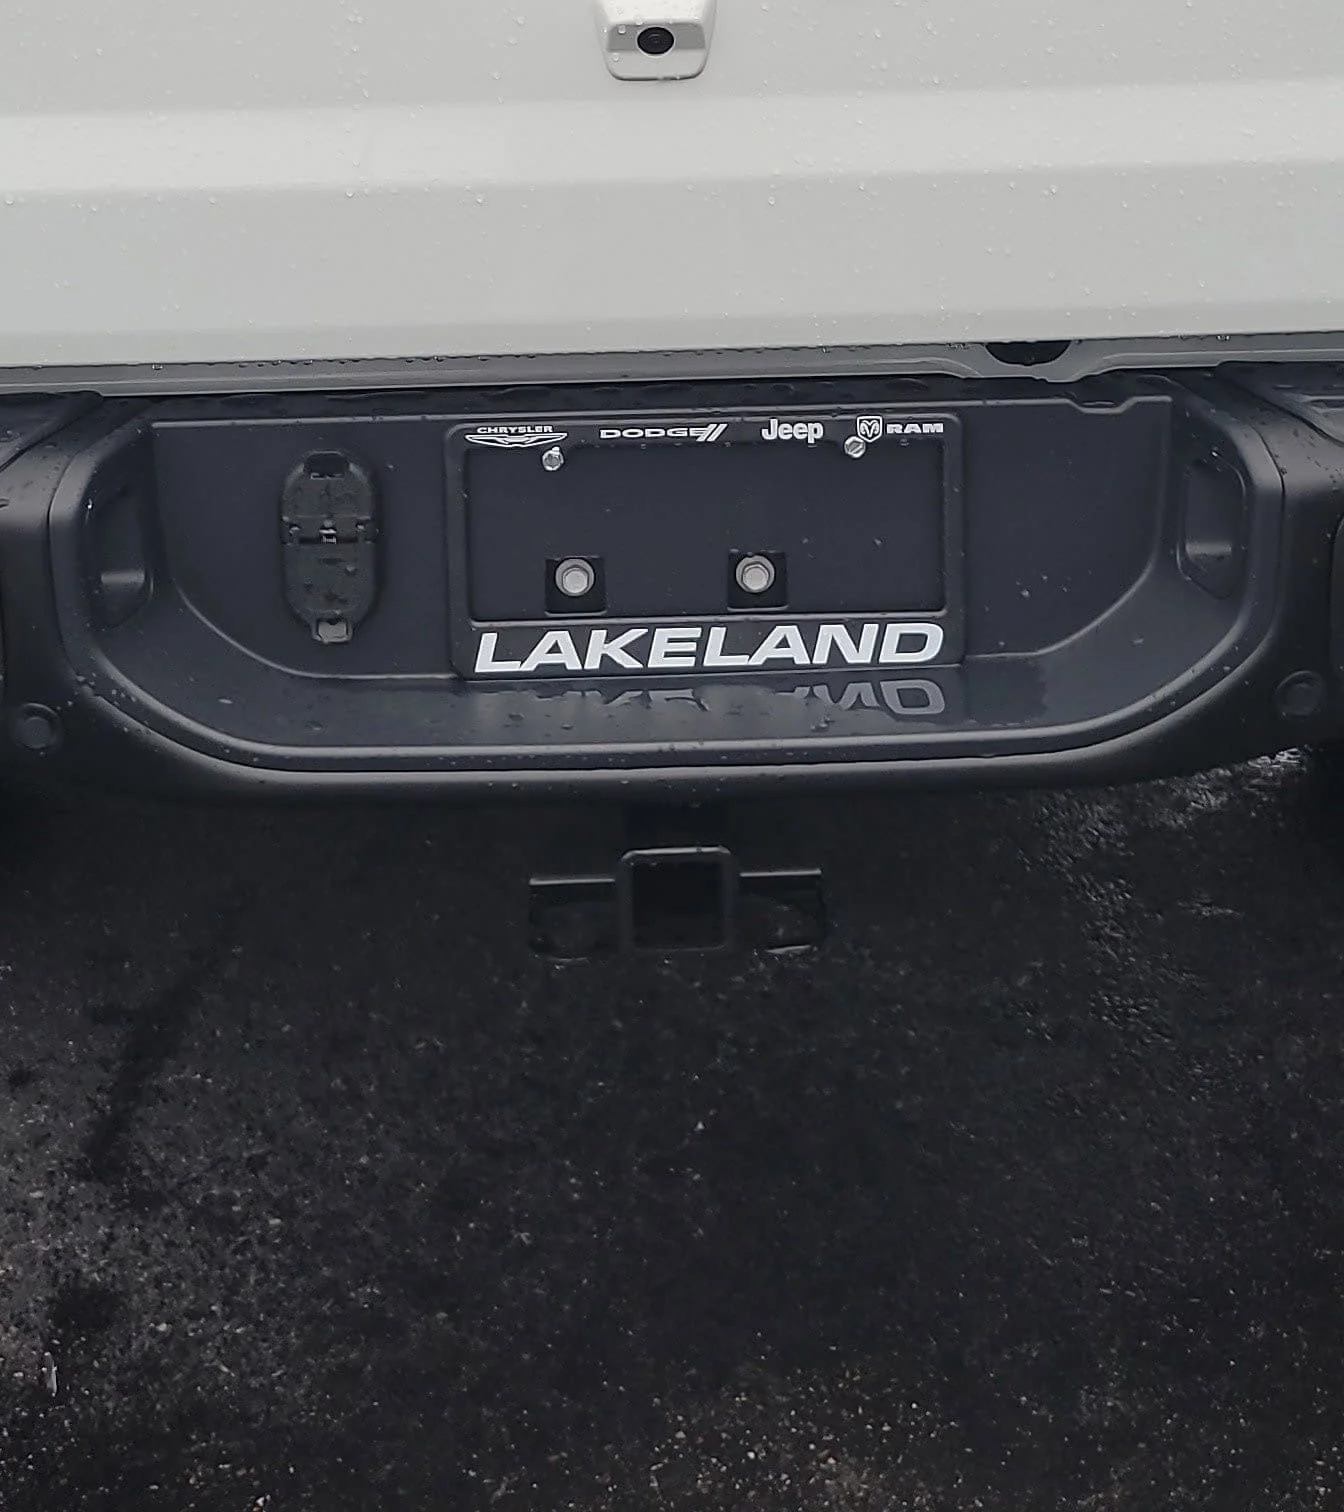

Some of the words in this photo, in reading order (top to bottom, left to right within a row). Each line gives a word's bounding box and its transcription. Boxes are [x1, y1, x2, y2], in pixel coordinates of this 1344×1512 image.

[476, 425, 554, 434] CHRYSLER
[599, 426, 707, 440] DODGE
[761, 418, 824, 444] Jeep
[886, 422, 944, 434] RAM
[474, 622, 945, 673] LAKELAND
